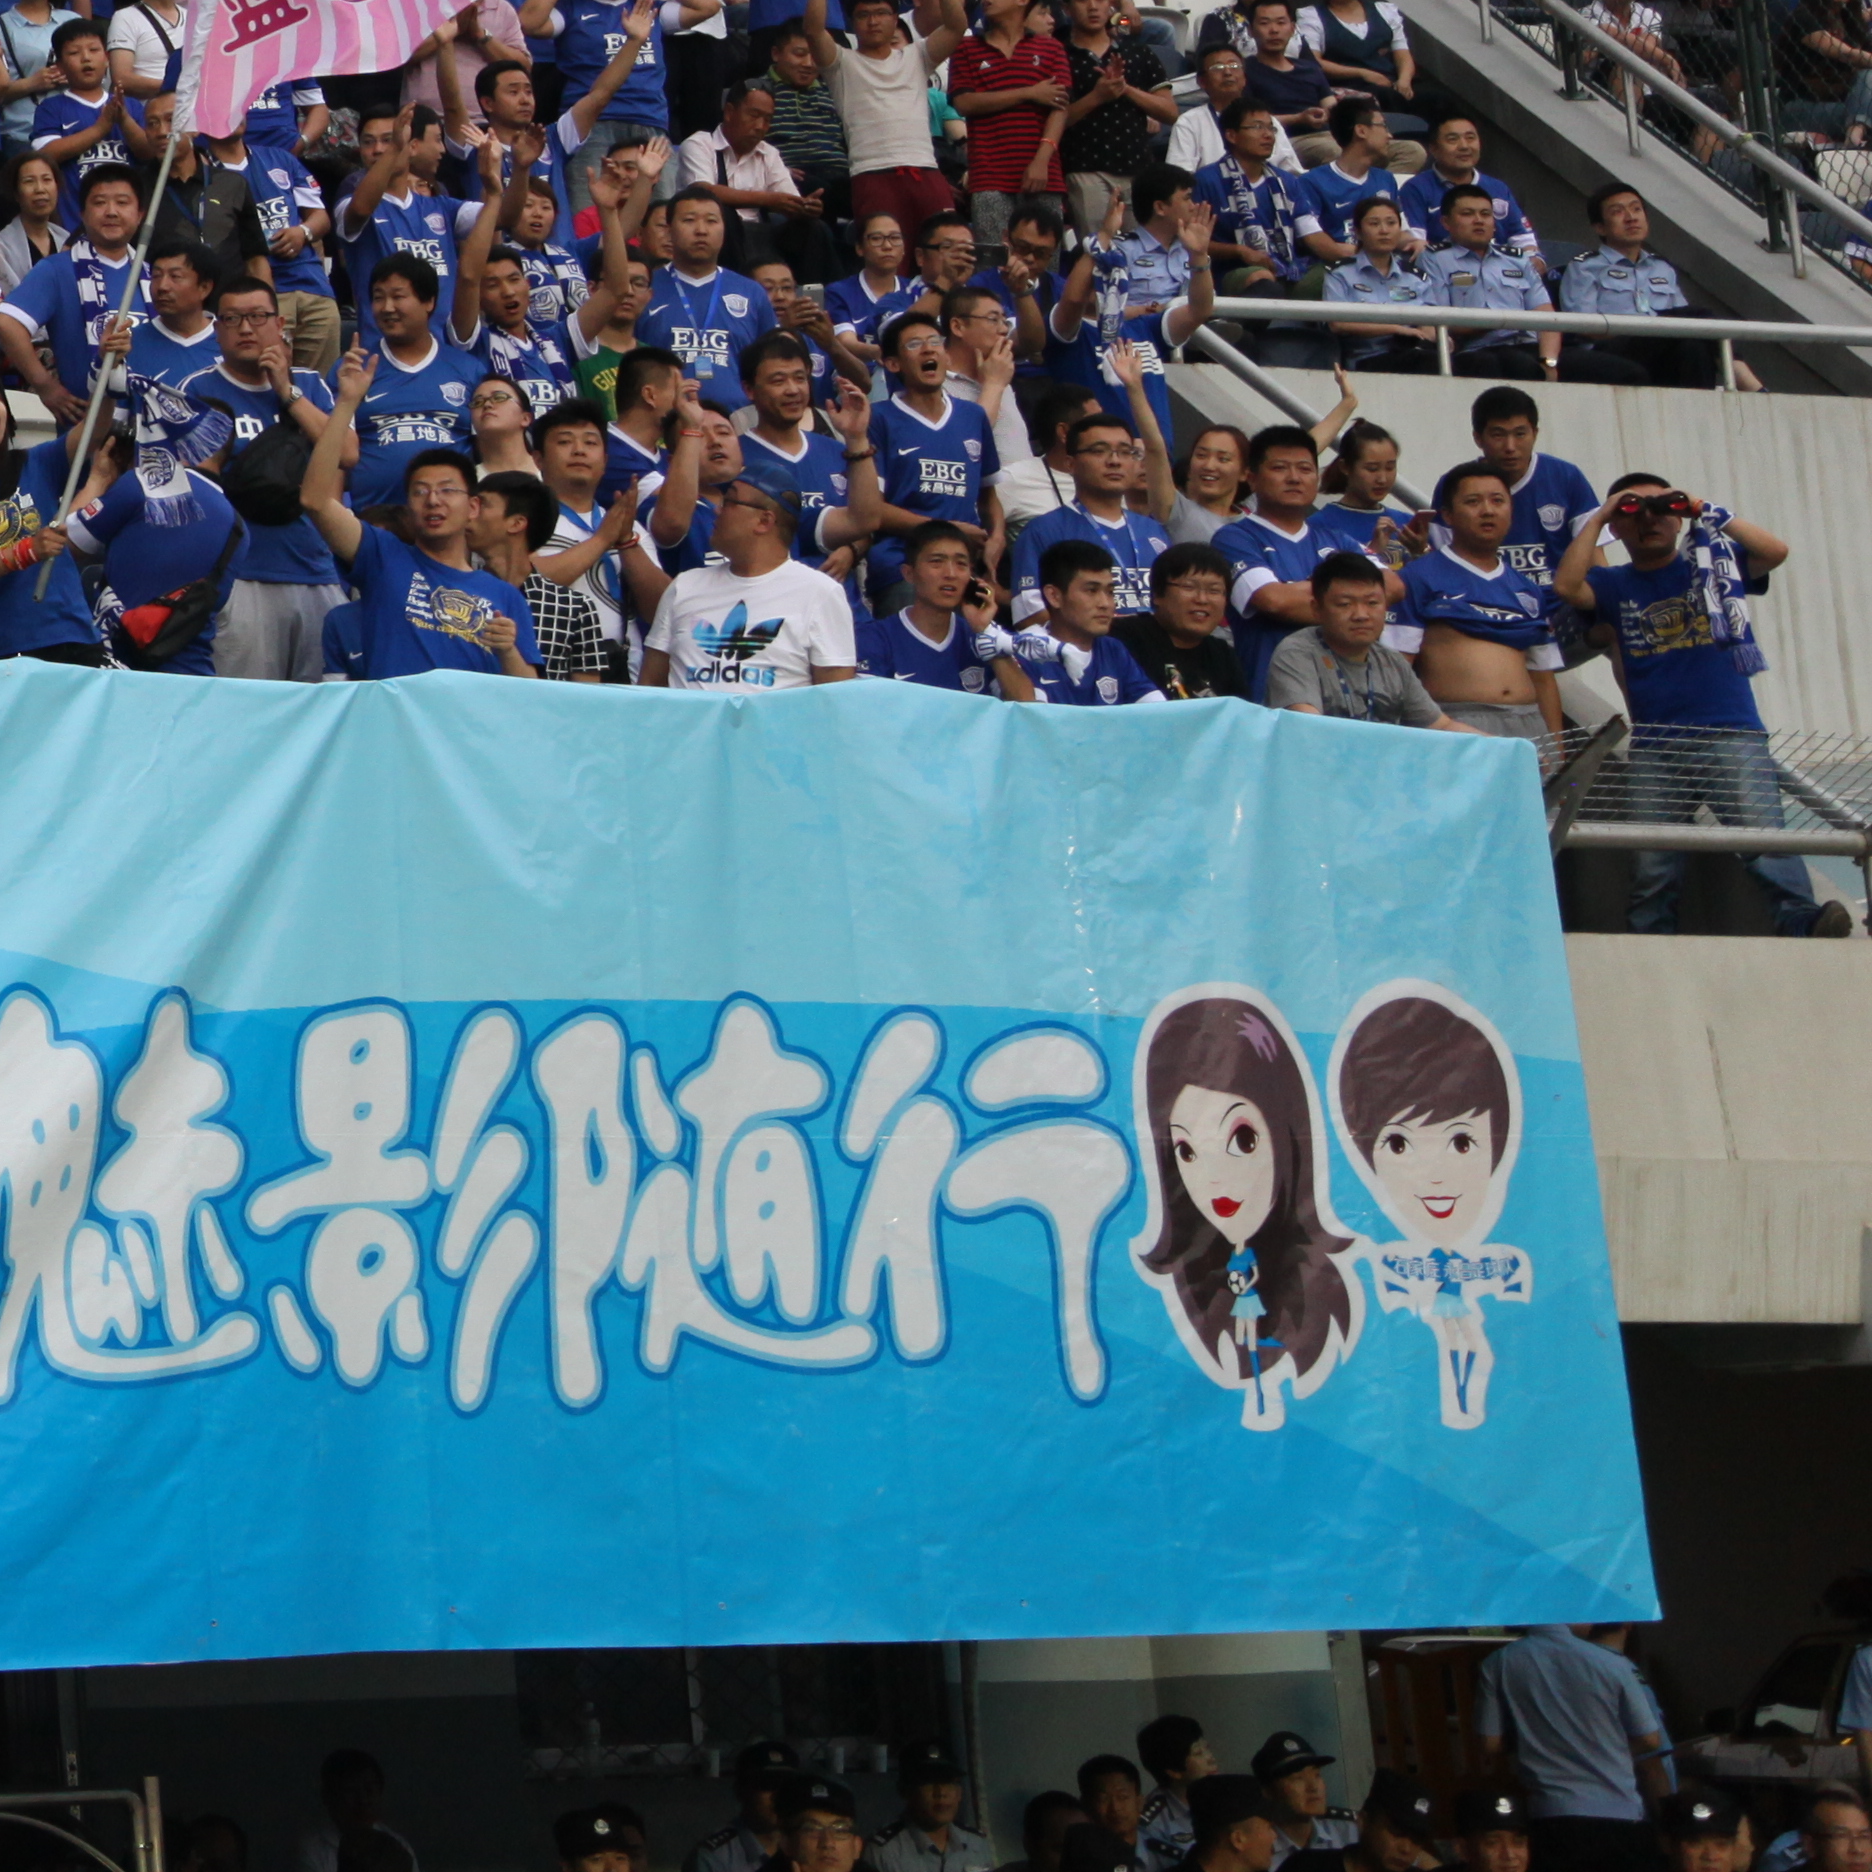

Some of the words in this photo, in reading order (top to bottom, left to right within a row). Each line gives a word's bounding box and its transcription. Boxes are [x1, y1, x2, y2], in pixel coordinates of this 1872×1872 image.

[604, 34, 653, 55] EG
[80, 140, 129, 162] EBG
[671, 329, 728, 349] EBG
[235, 414, 279, 442] 中
[920, 462, 965, 482] EBG
[687, 660, 777, 688] adidas
